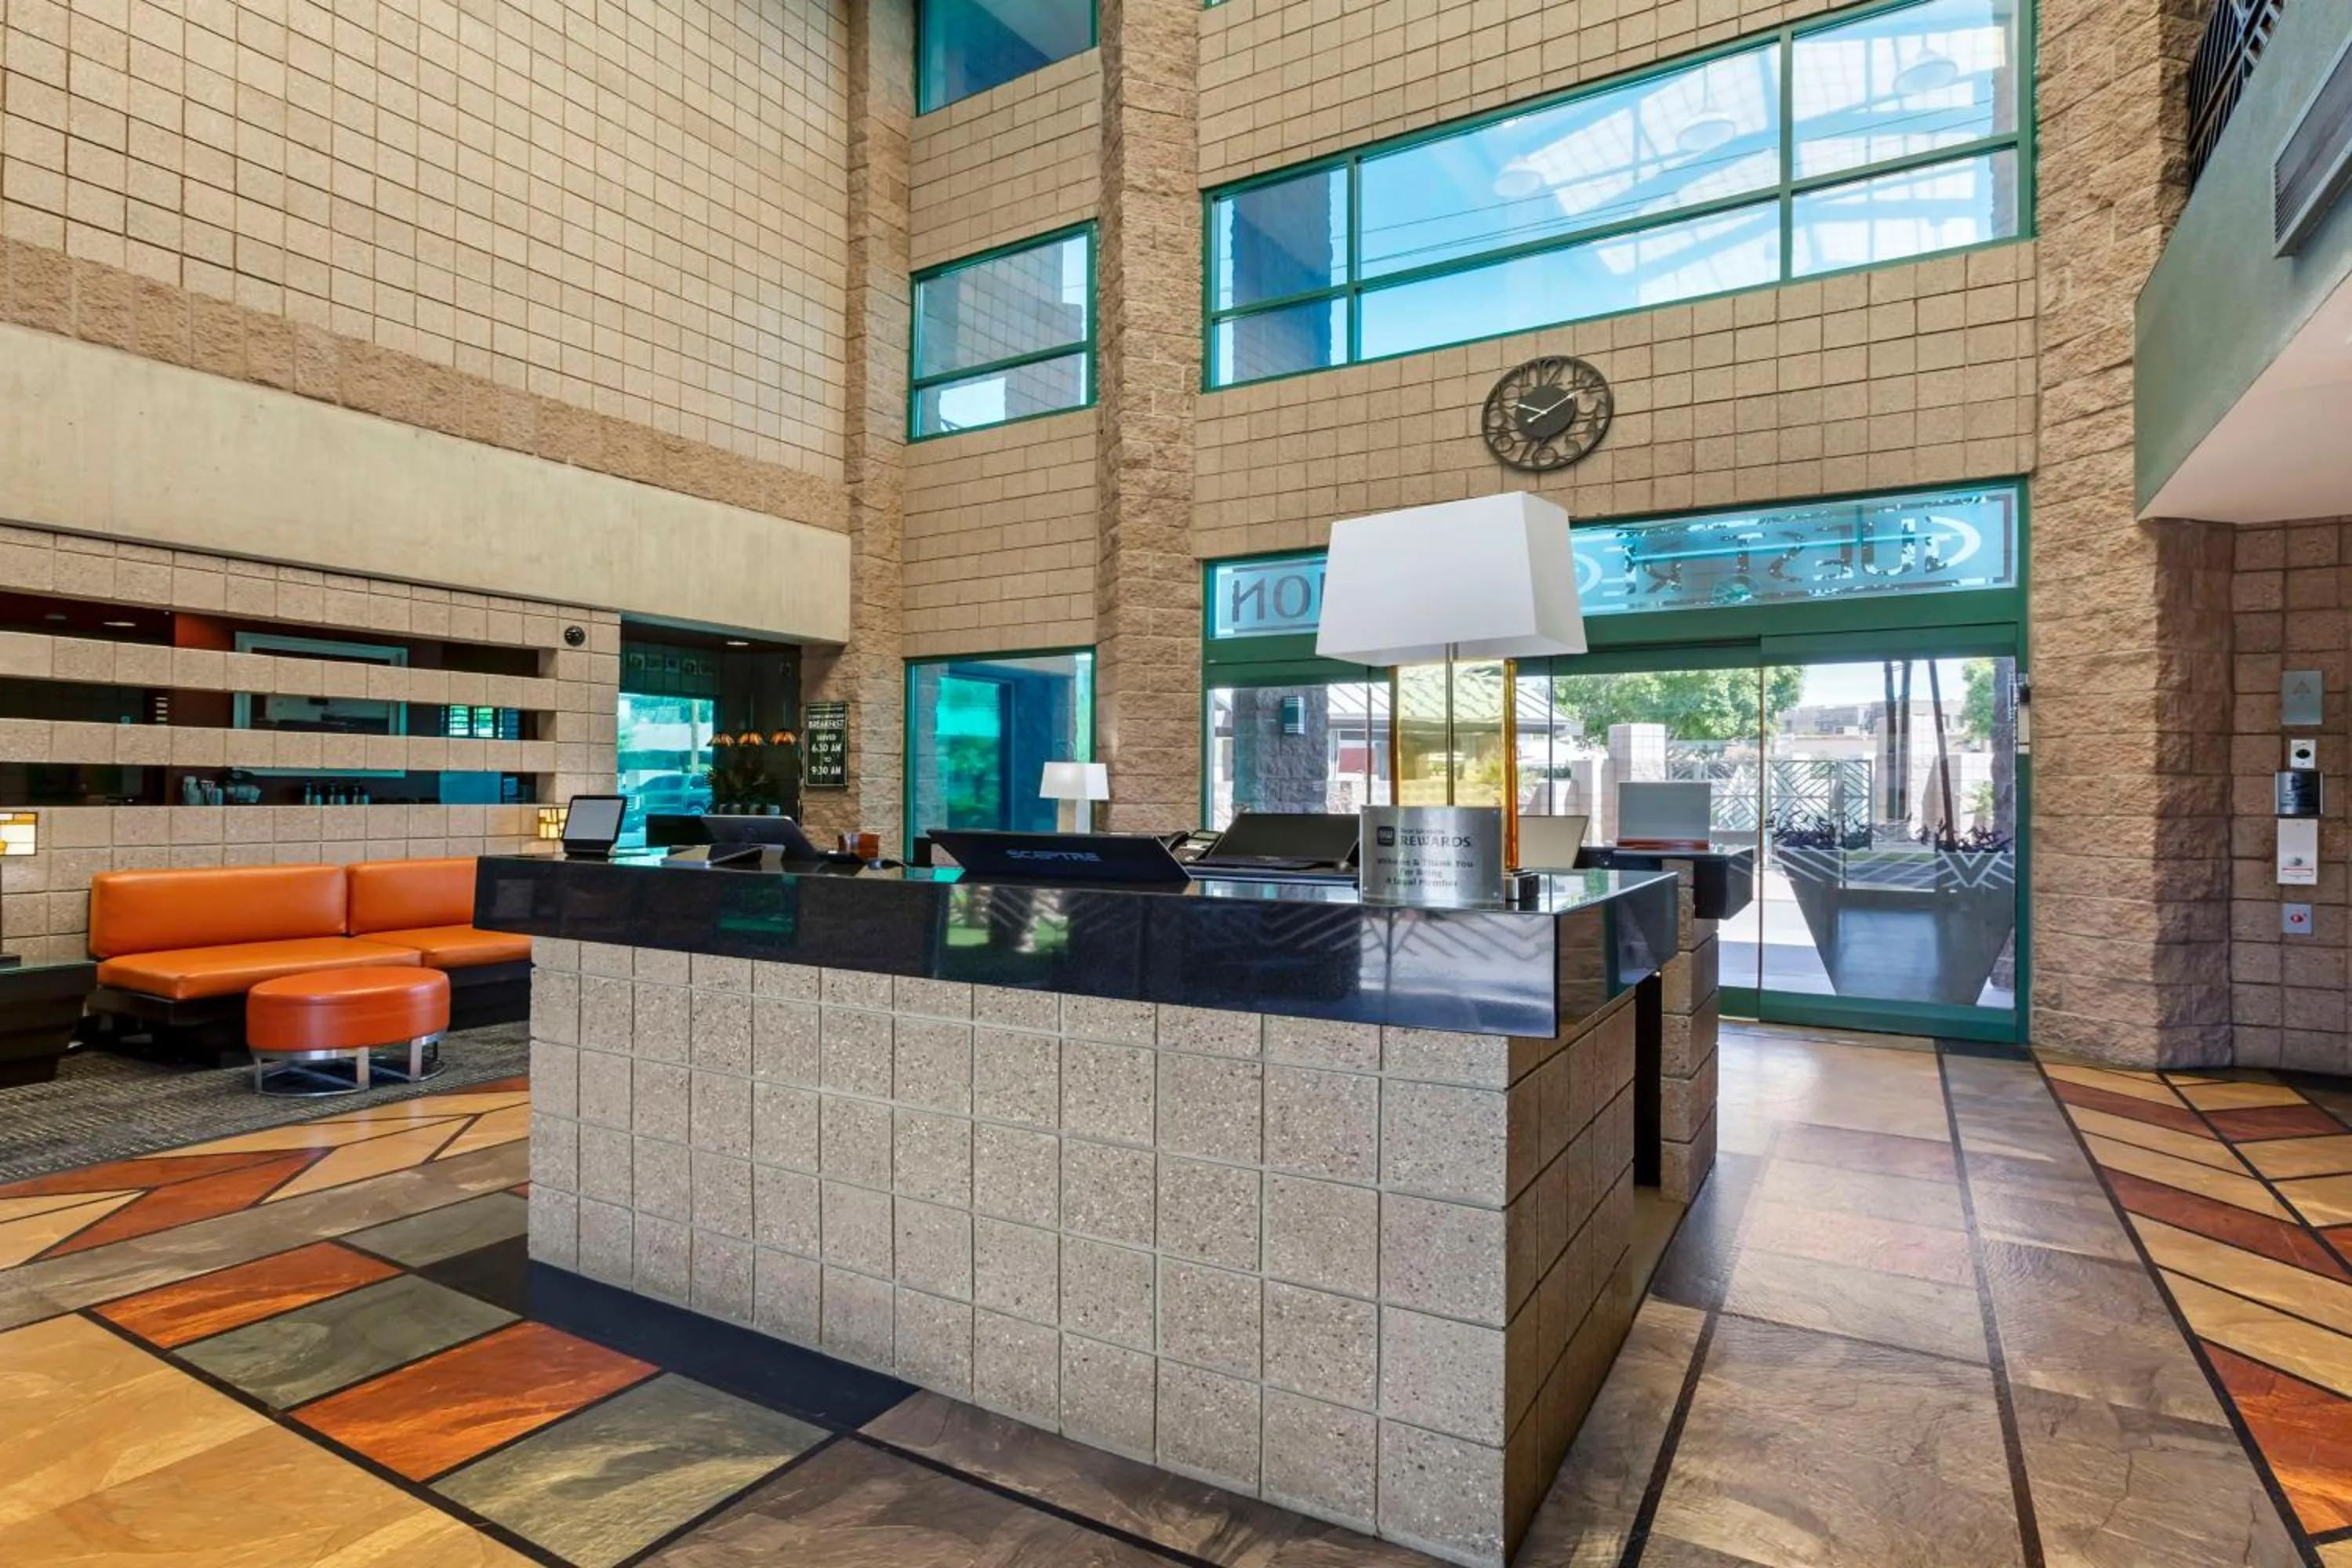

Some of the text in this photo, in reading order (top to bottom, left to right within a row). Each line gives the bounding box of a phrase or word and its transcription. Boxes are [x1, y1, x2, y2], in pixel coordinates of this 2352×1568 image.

[830, 766, 842, 775] AM
[1399, 836, 1472, 848] REWARDS
[1005, 849, 1103, 862] SCEPTRE
[1454, 859, 1474, 868] You
